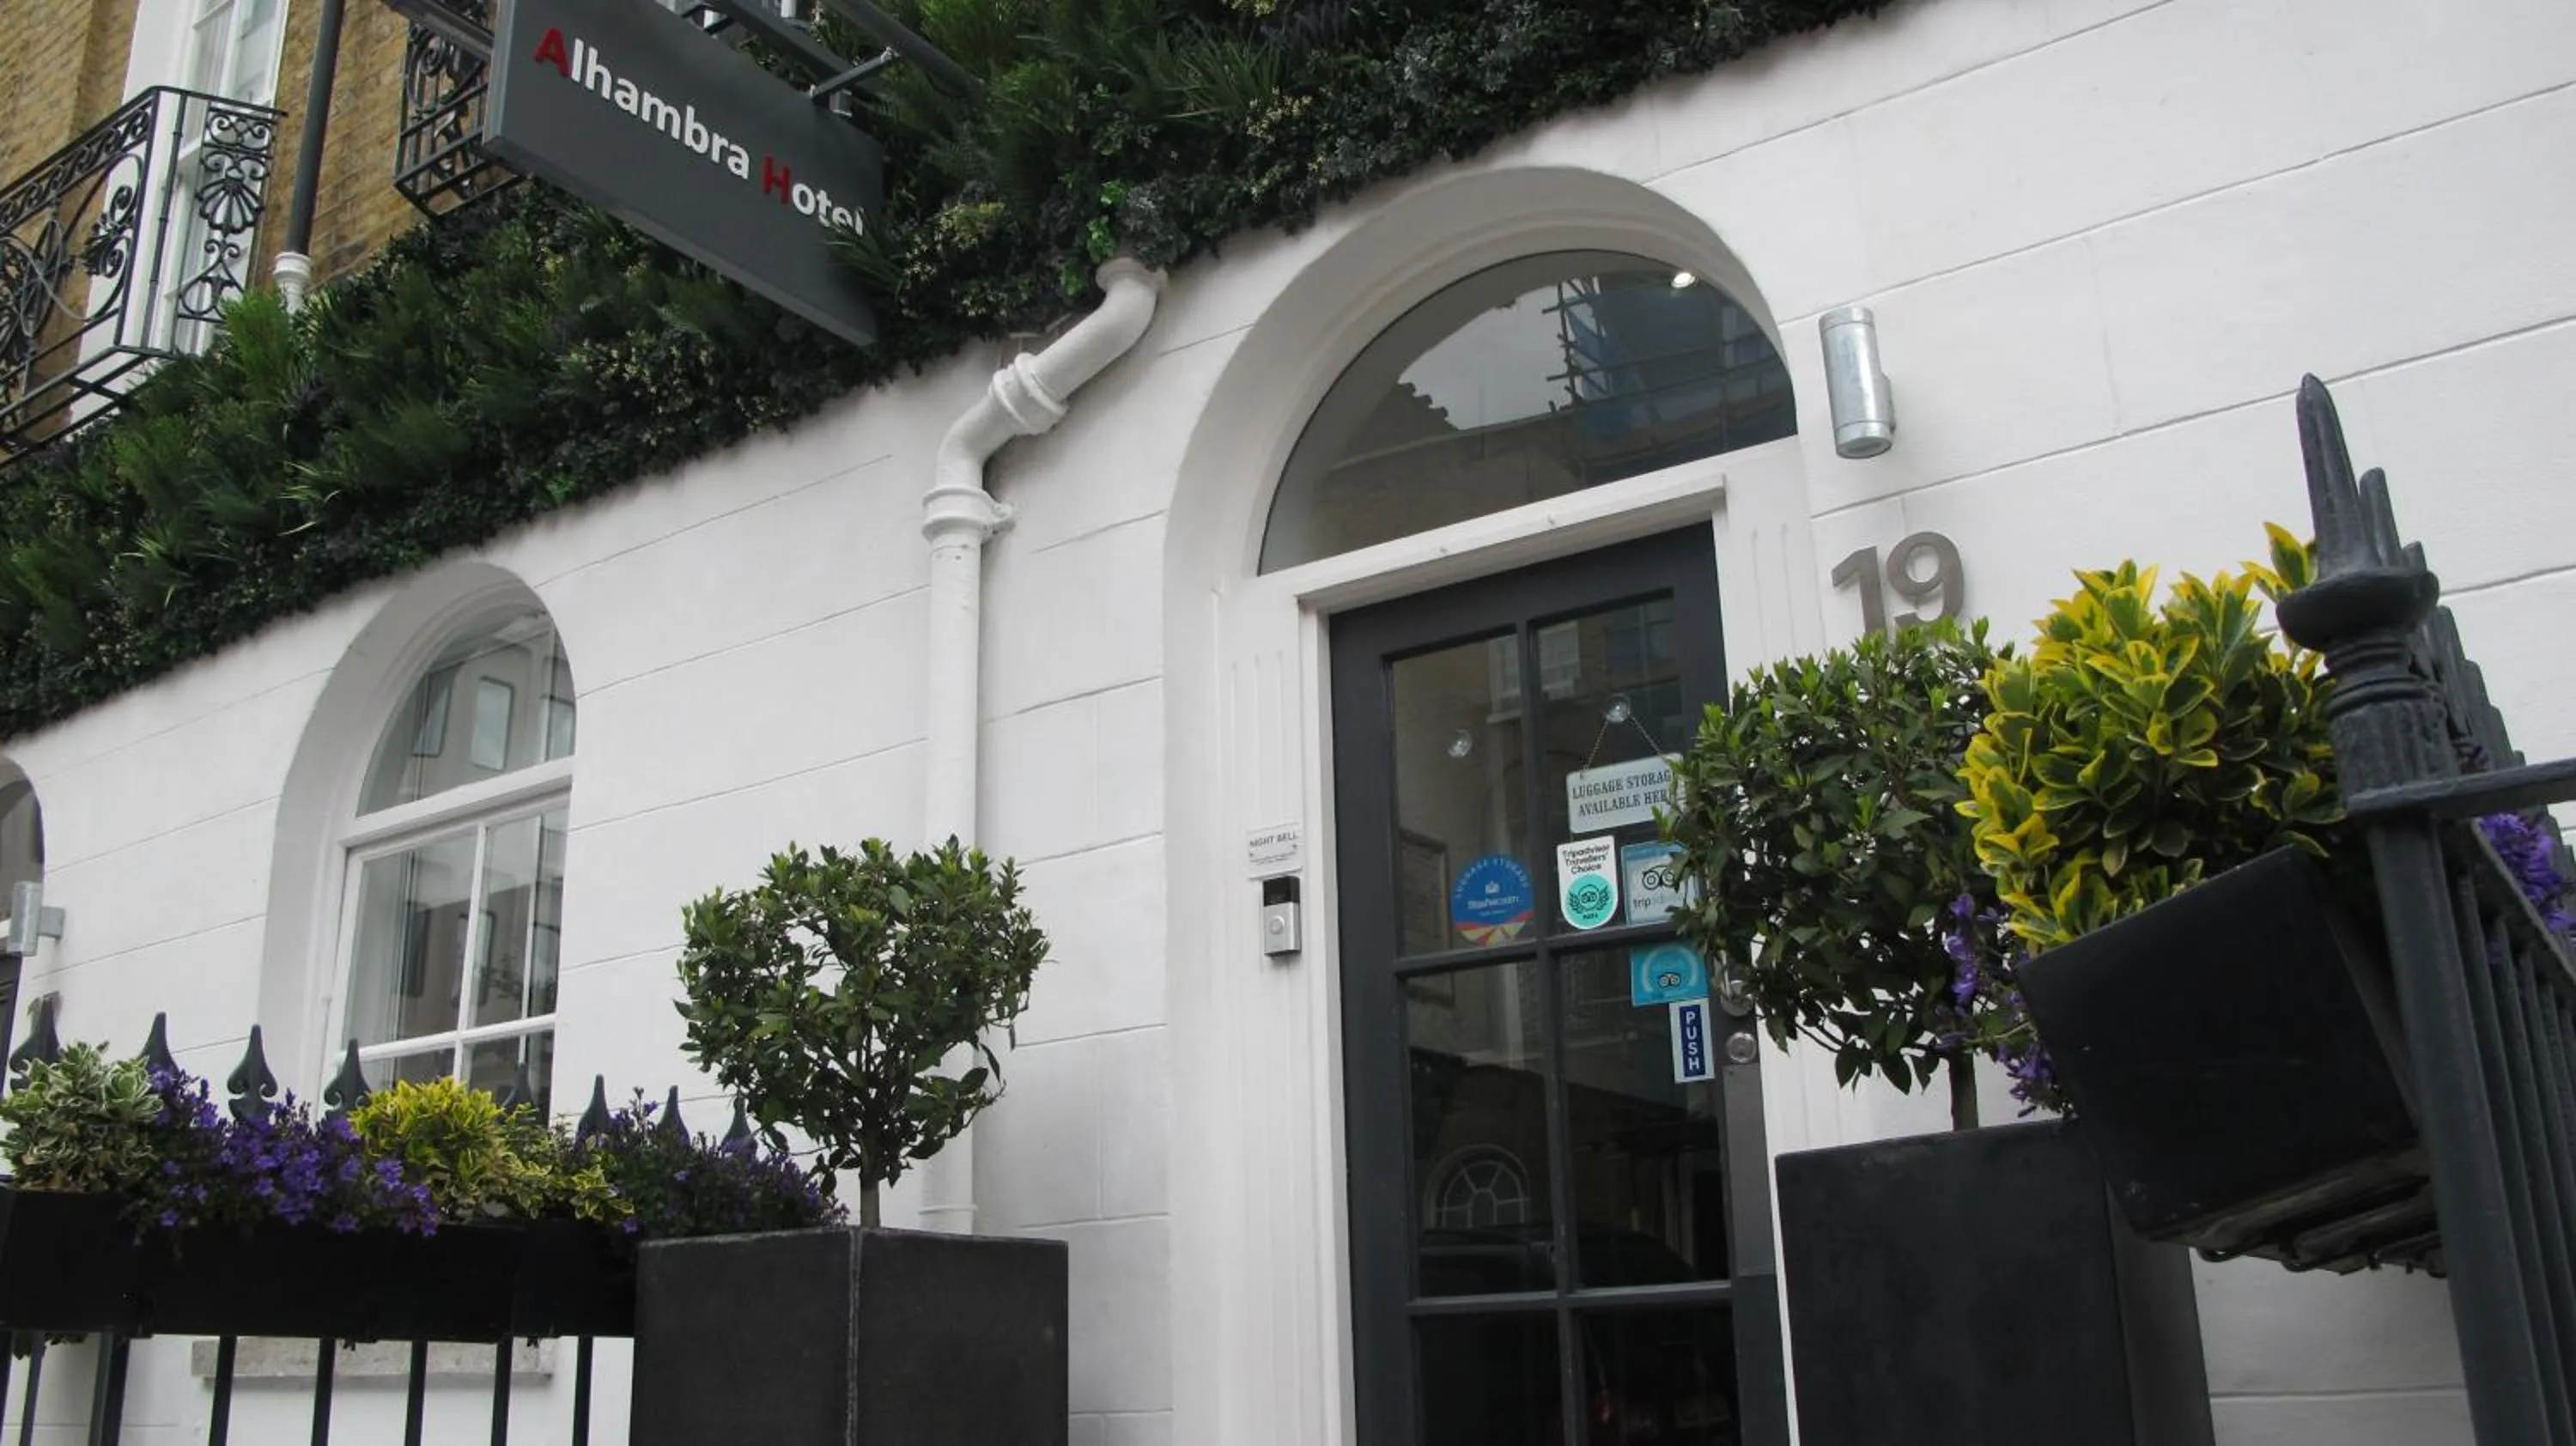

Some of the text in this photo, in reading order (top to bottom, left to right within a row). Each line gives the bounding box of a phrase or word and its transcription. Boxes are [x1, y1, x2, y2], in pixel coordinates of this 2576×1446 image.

[533, 27, 864, 236] Alhambra Hotel
[1832, 531, 1964, 639] 19
[1572, 769, 1673, 799] LUGGAGE STORAG
[1578, 788, 1671, 817] AVAILABLE HER
[1249, 830, 1297, 847] NIGHT BELL
[1571, 864, 1601, 874] Choice
[1686, 1011, 1699, 1071] PUSH
